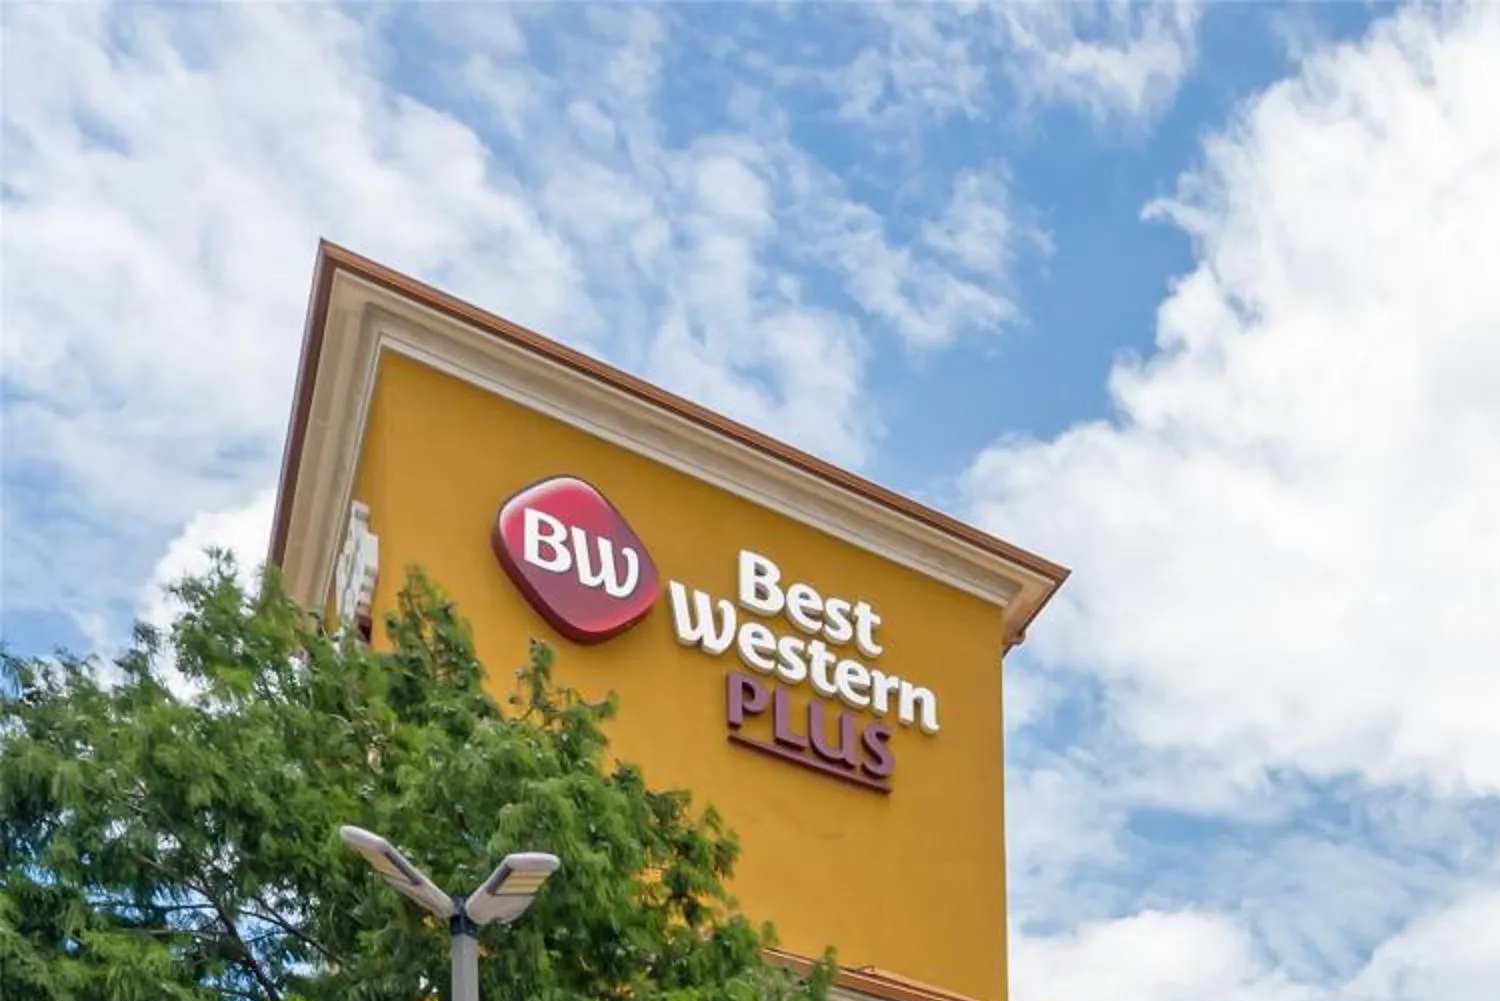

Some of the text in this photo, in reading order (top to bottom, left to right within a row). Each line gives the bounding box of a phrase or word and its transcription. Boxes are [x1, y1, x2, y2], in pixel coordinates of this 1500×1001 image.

[524, 507, 640, 598] BW
[738, 548, 883, 658] Best
[669, 579, 941, 734] Western
[725, 670, 895, 777] PLUS
